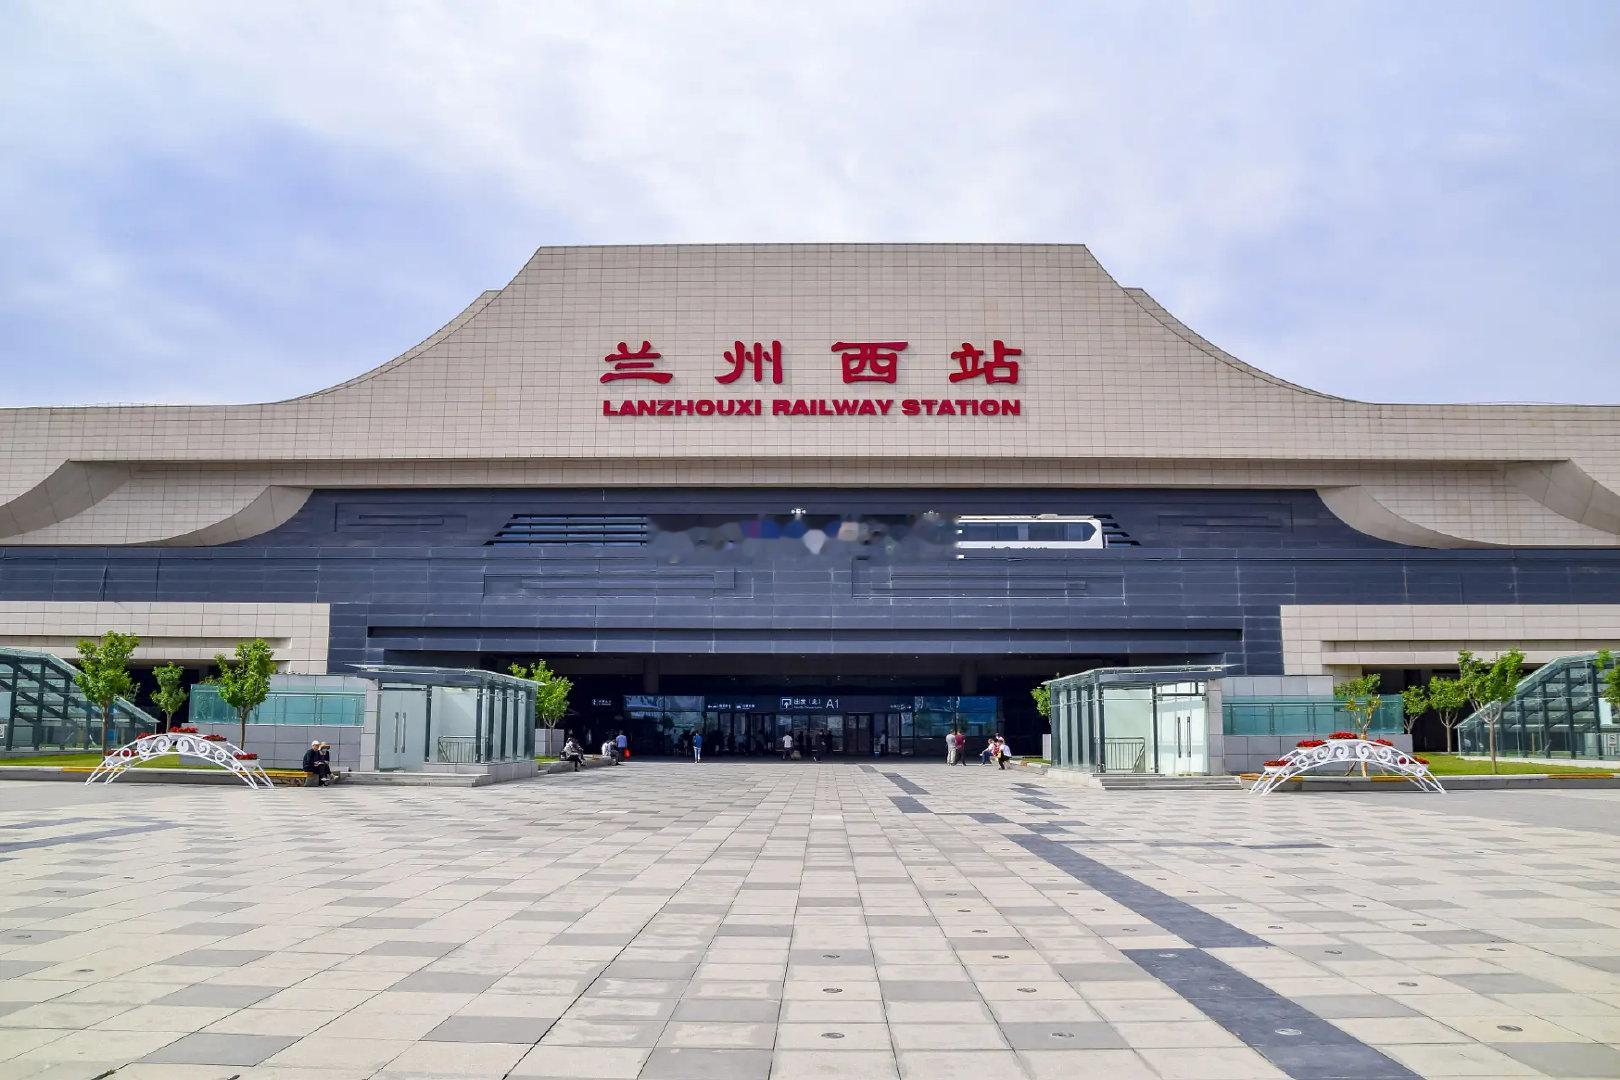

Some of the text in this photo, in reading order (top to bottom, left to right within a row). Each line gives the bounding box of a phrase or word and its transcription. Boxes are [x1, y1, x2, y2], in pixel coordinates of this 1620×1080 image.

[600, 340, 1022, 385] 兰州西站
[603, 399, 1021, 416] LANZHOUXI RAILWAY STATION
[826, 699, 839, 708] A1
